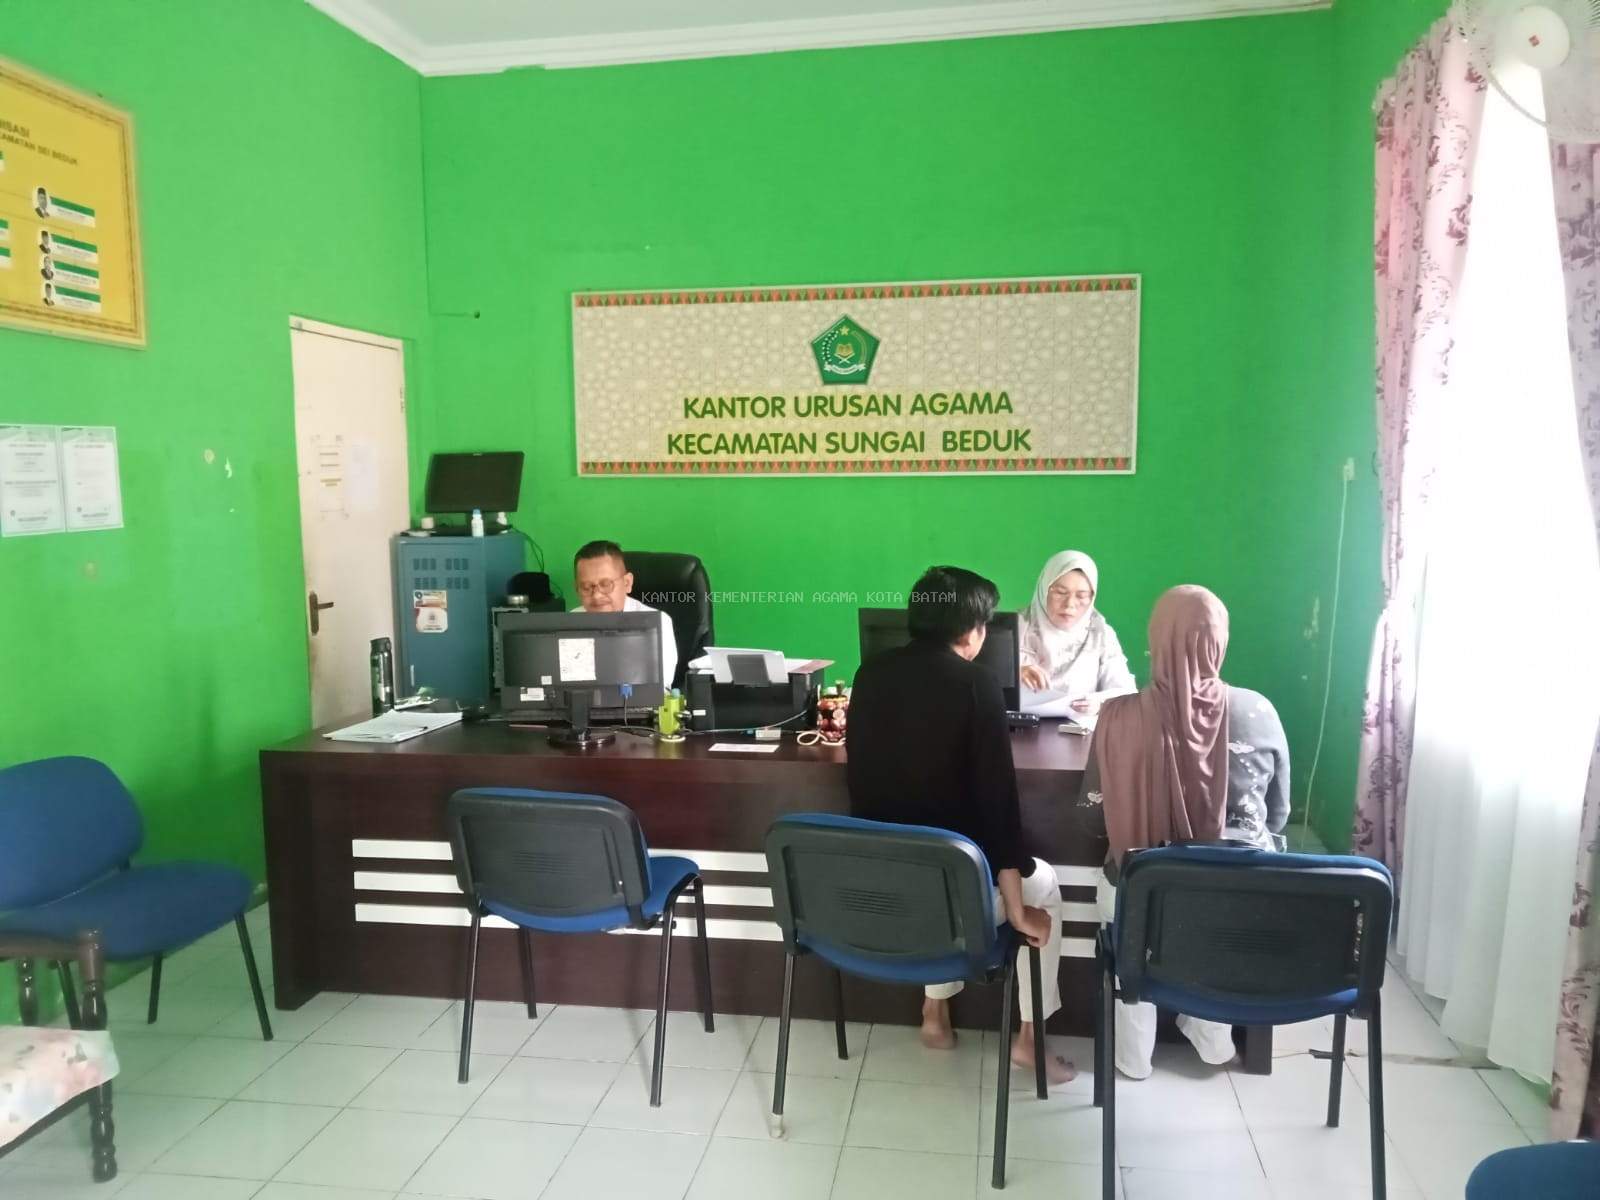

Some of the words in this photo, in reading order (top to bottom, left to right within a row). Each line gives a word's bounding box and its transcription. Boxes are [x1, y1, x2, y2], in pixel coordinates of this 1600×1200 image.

[684, 396, 785, 418] KANTOR
[794, 394, 901, 417] URUSAN
[909, 392, 1013, 415] AGAMA
[668, 432, 816, 455] KECAMATAN
[825, 431, 925, 453] SUNGAI
[942, 429, 1032, 452] BEDUK
